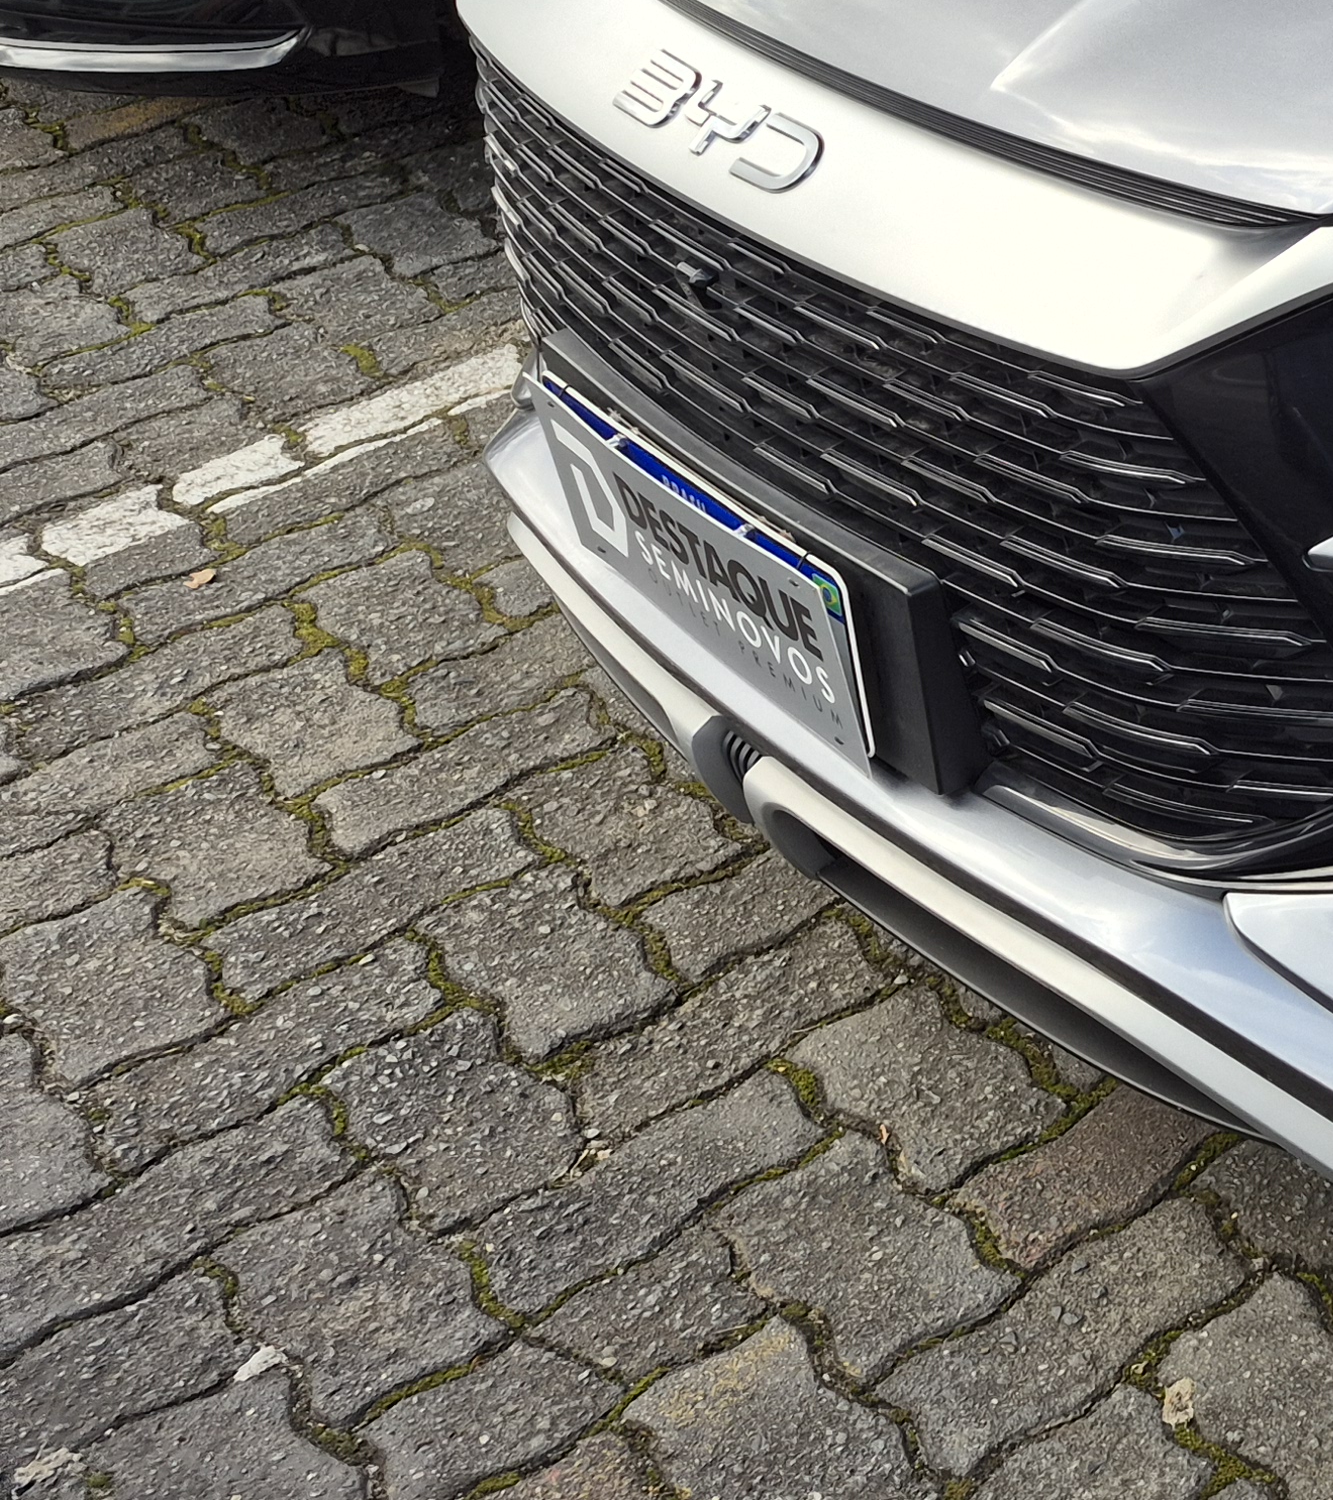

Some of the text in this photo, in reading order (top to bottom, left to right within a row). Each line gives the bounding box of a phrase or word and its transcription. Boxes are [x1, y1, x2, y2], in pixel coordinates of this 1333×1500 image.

[611, 47, 826, 195] BYD
[612, 470, 825, 663] DESTAQUE
[633, 529, 836, 706] SEMINOVOS
[737, 638, 844, 731] PREMIUM
